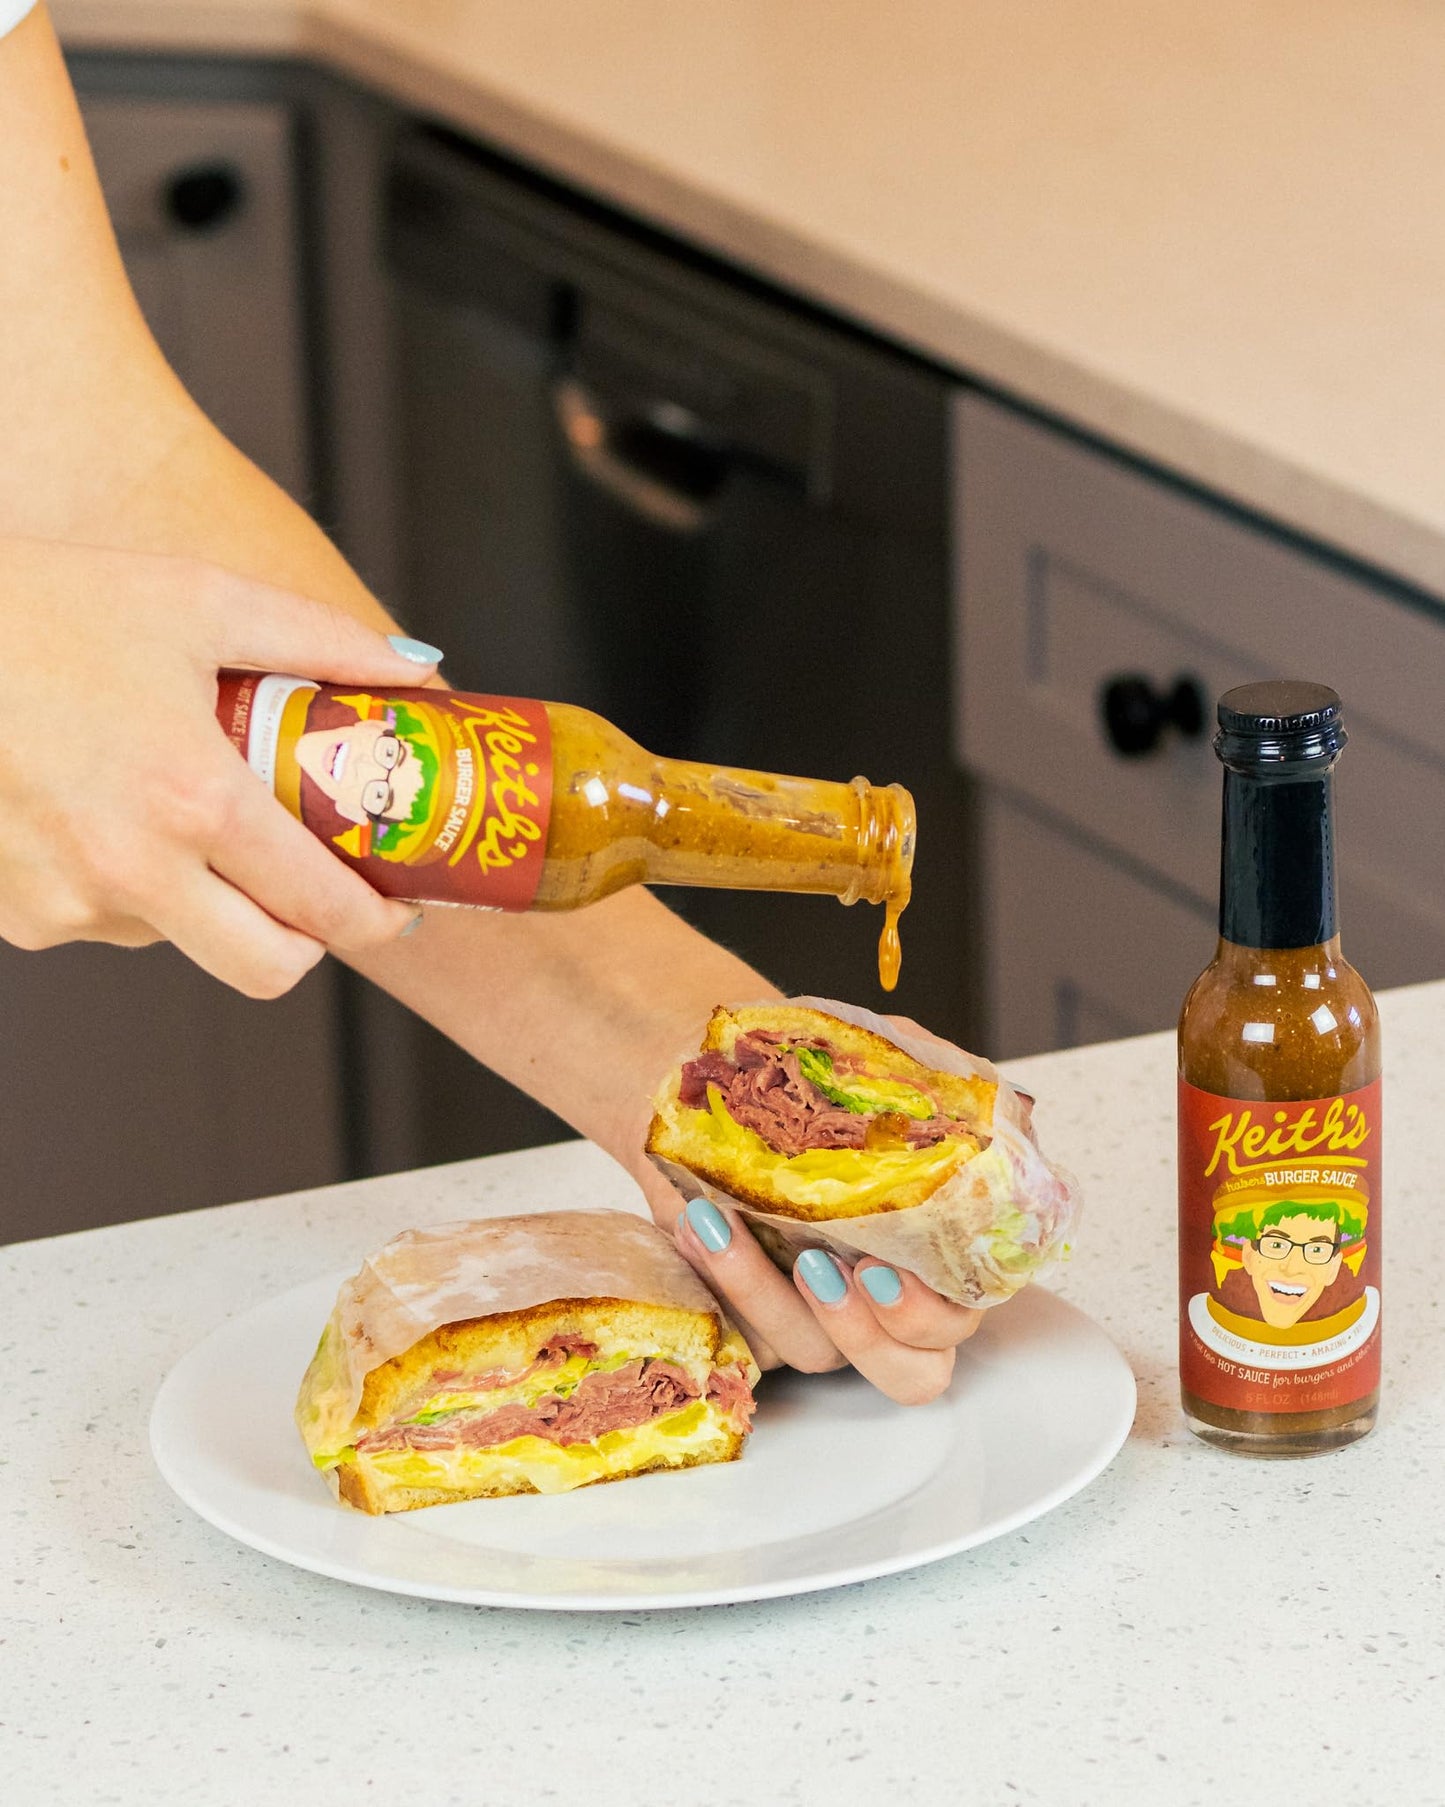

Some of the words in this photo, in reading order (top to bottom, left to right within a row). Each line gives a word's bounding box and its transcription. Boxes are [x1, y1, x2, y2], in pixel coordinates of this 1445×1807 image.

[236, 686, 252, 703] HOT
[232, 703, 249, 734] SAUCE
[448, 698, 542, 876] Keith's
[433, 805, 467, 852] SAUCE
[1204, 1097, 1371, 1176] Keith's
[1321, 1170, 1358, 1189] SAUCE
[1211, 1326, 1246, 1352] DELICIOUS
[1259, 1348, 1299, 1360] PERFECT
[1311, 1338, 1347, 1357] AMAZING
[1217, 1358, 1237, 1375] HOT
[1238, 1368, 1271, 1384] SAUCE
[1272, 1372, 1291, 1388] for
[1294, 1369, 1335, 1384] burgers
[1336, 1359, 1354, 1373] and
[1273, 1393, 1290, 1405] OZ
